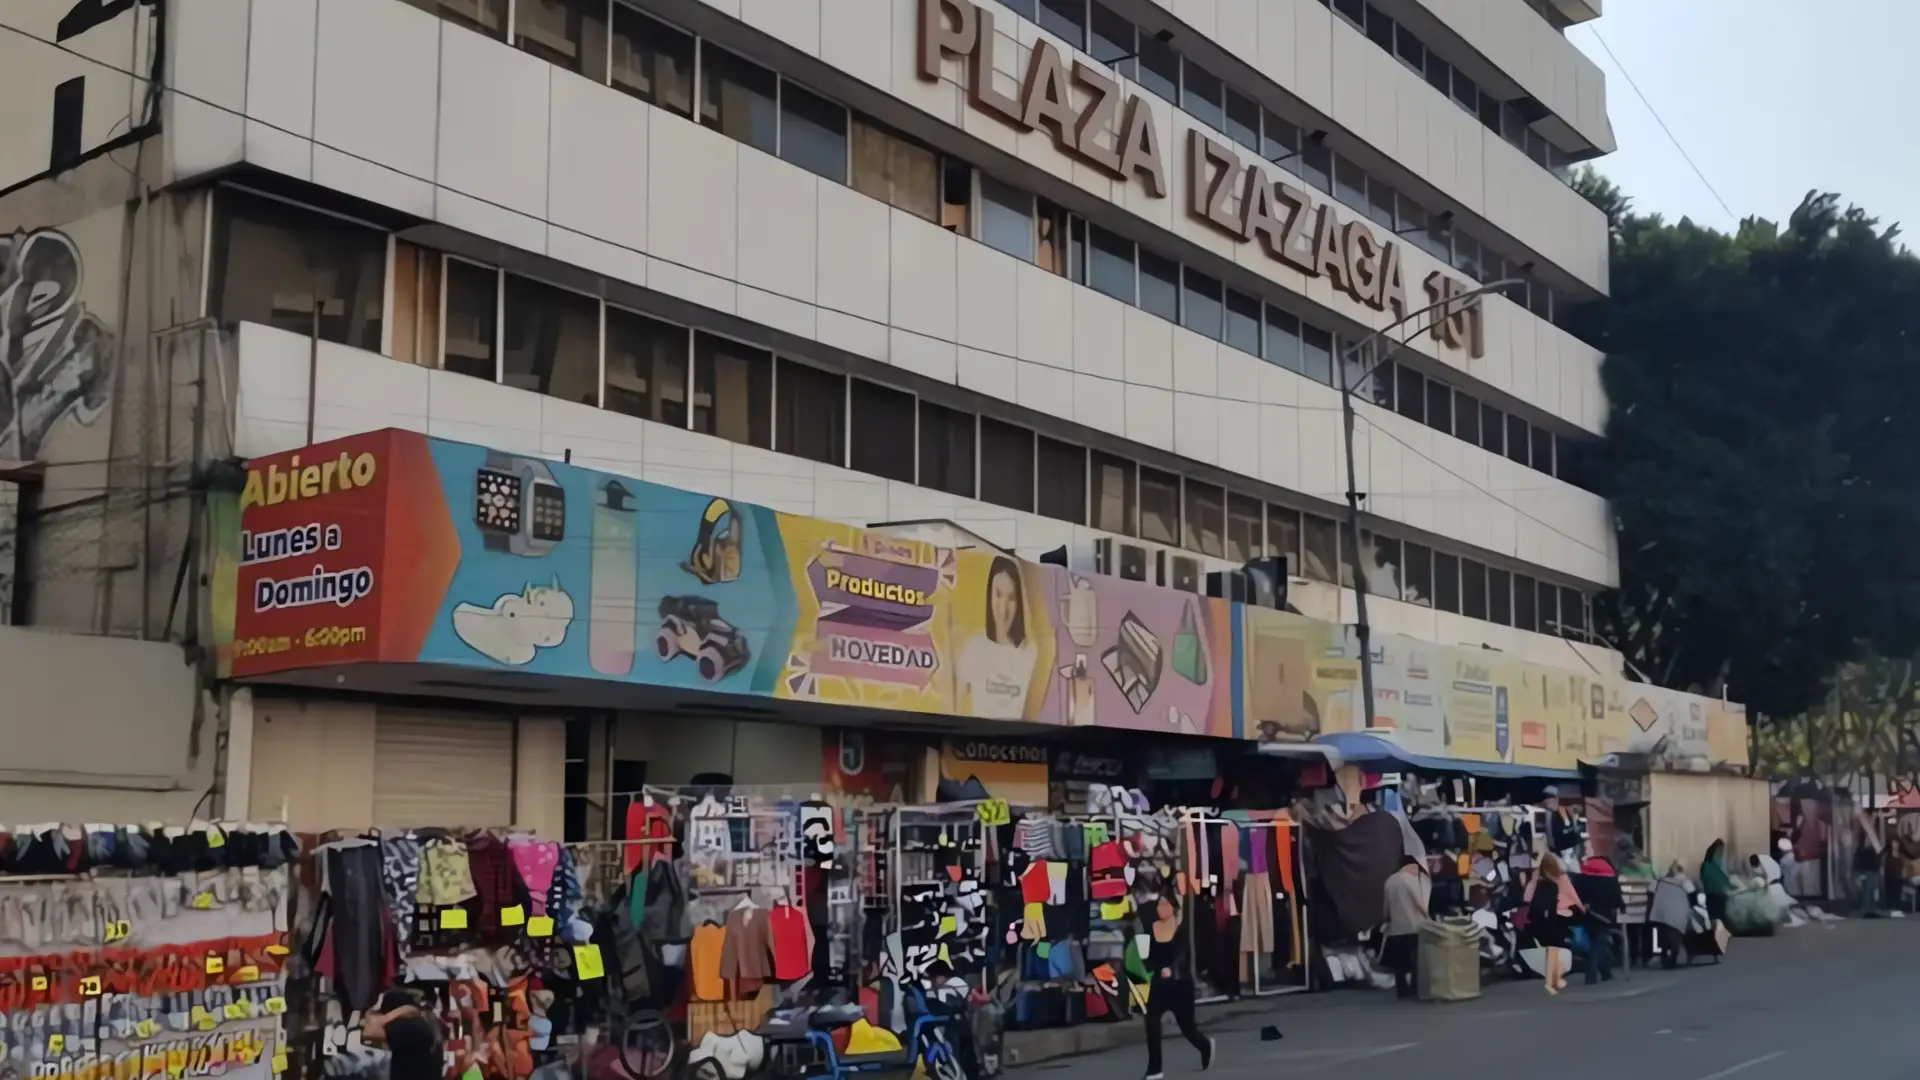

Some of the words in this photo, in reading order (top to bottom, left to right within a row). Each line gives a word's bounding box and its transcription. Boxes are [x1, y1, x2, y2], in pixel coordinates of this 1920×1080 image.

[917, 0, 1166, 199] PLAZA
[1186, 128, 1408, 323] IZAZAGA
[240, 452, 376, 512] Abierto
[240, 523, 321, 566] Lunes
[325, 524, 342, 550] a
[255, 564, 374, 613] Domingo
[831, 637, 934, 669] NOVEDAD
